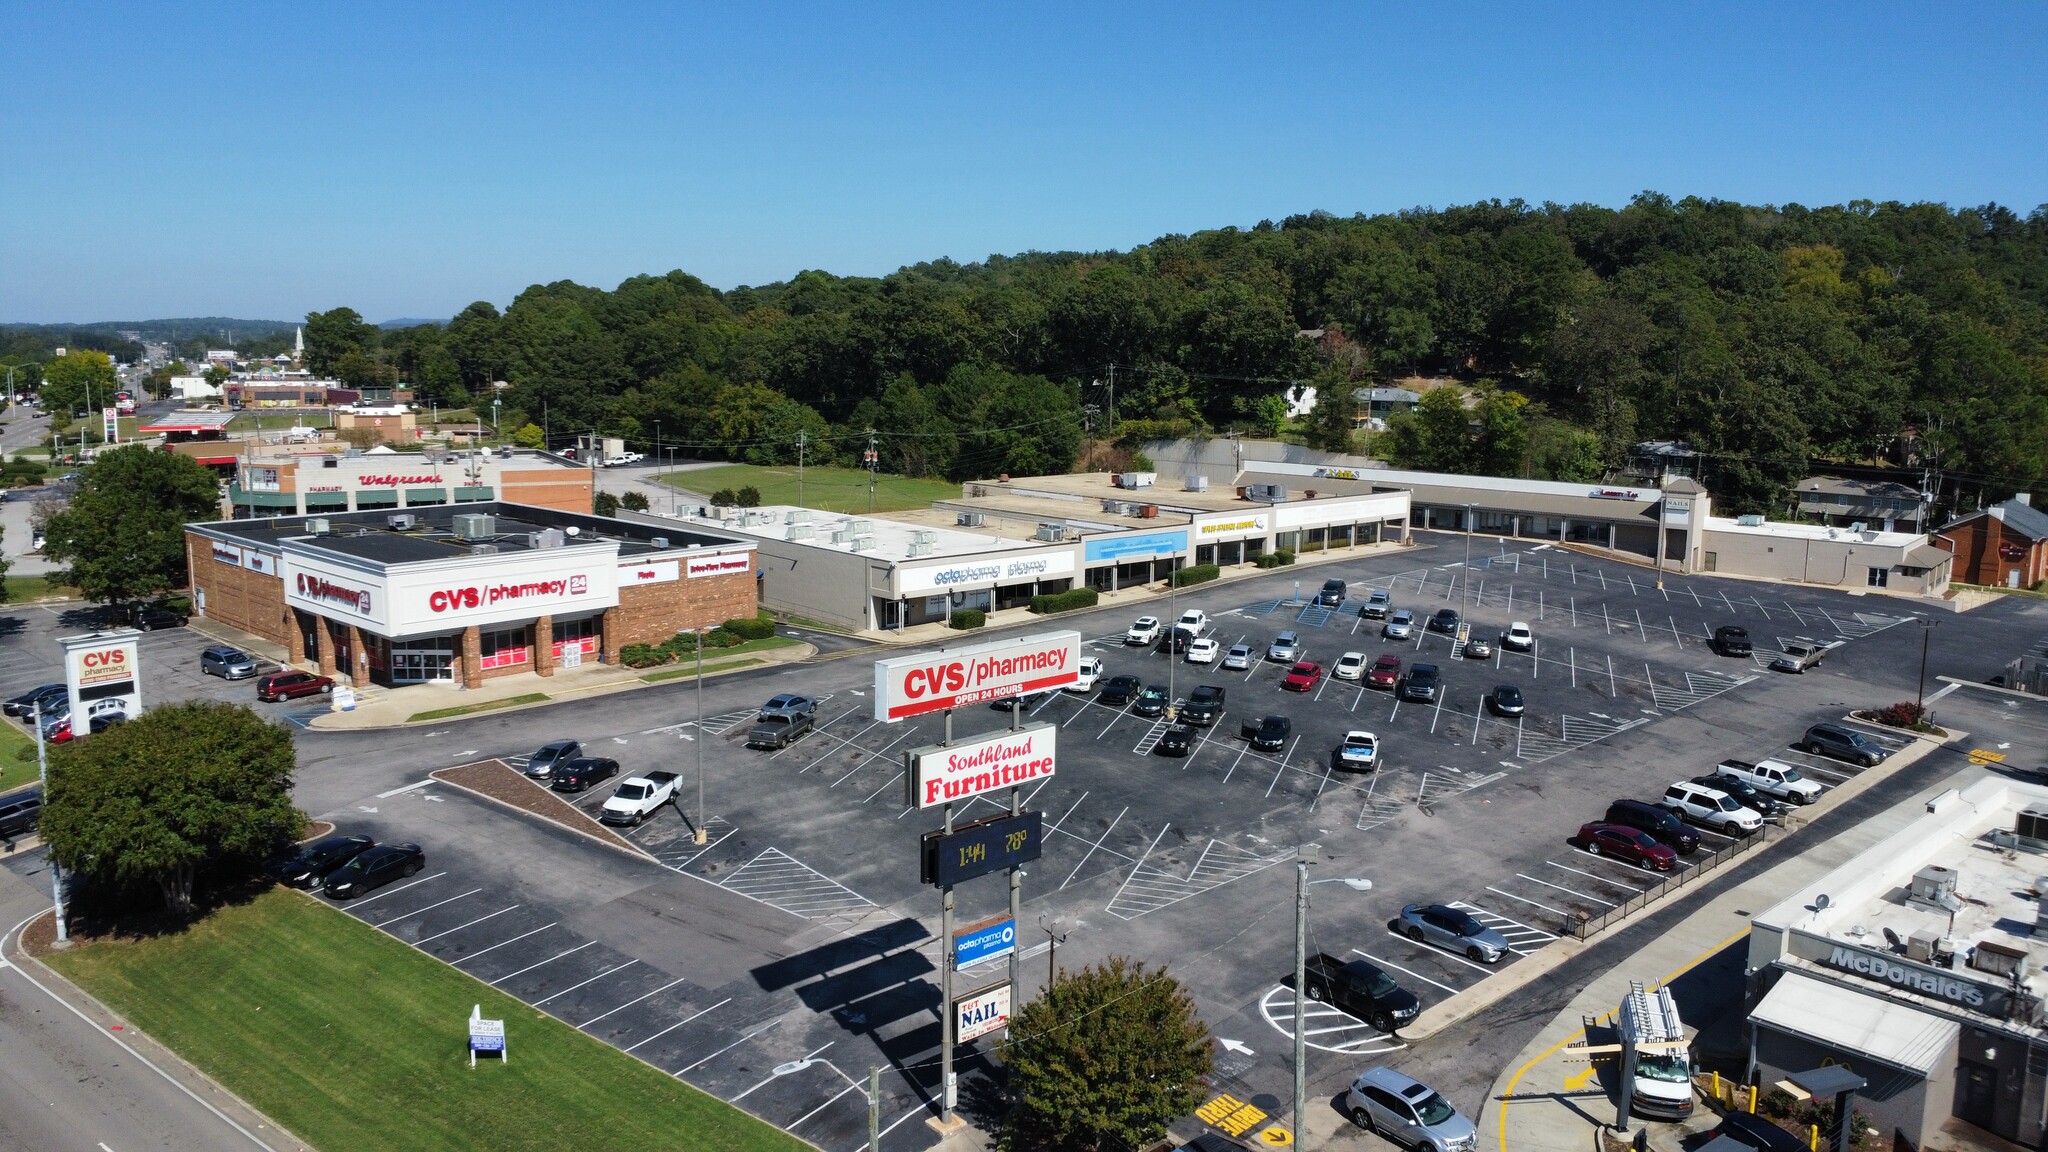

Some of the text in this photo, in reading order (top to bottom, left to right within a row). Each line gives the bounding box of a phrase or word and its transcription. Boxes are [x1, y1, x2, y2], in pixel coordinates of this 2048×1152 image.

[358, 474, 443, 488] Walgreens
[571, 576, 586, 588] 24
[83, 649, 125, 667] CVS
[84, 664, 126, 677] pharmacy
[954, 684, 1023, 705] OPEN 24 HOURS
[947, 736, 1032, 773] Southland
[925, 757, 1053, 803] Furniture
[958, 931, 1001, 951] octapharma
[983, 938, 1002, 950] plasma
[961, 1001, 999, 1029] NAIL
[962, 1000, 979, 1012] T&T
[1195, 1093, 1245, 1125] THRU
[1216, 1104, 1268, 1137] DRIVE
